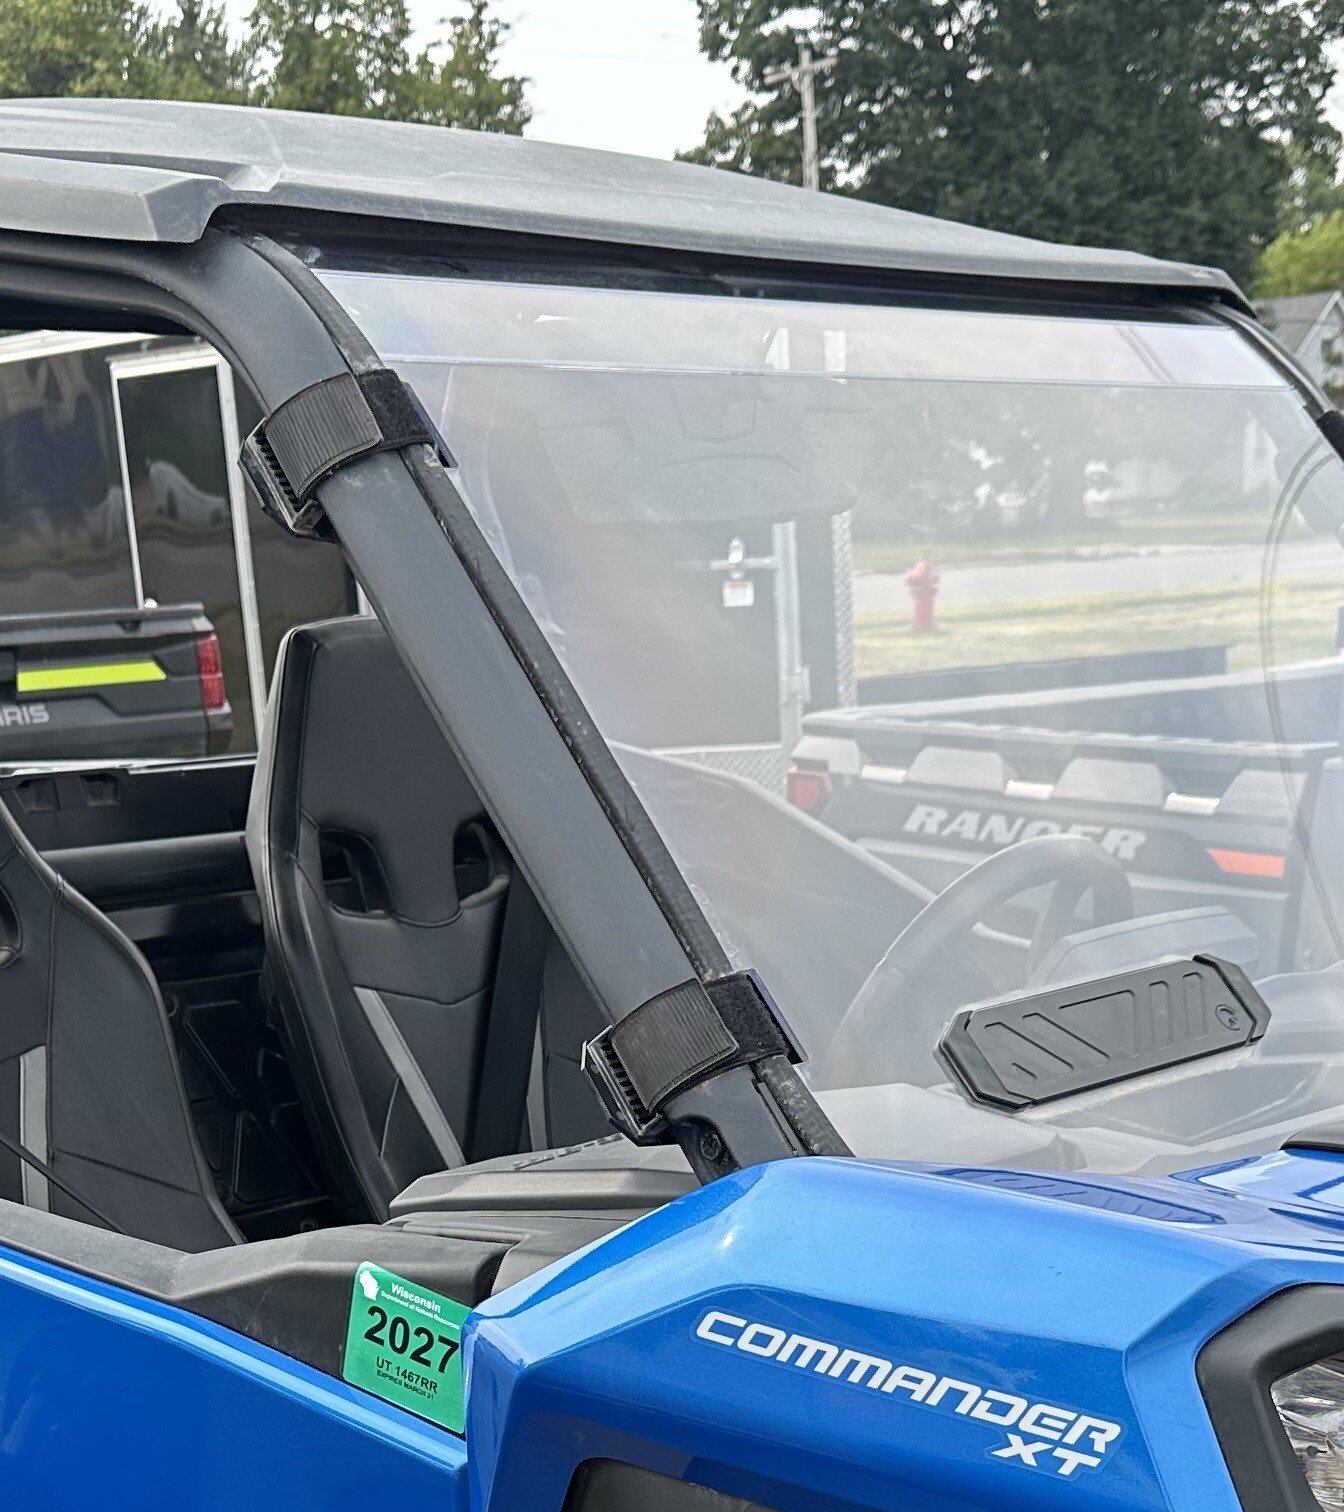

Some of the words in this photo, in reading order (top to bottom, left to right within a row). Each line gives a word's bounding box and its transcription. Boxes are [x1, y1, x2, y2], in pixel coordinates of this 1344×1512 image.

[391, 1282, 442, 1314] Wisconsin
[364, 1305, 460, 1374] 2027
[376, 1355, 393, 1371] UT
[396, 1365, 438, 1395] 1467RR
[695, 1310, 1122, 1454] COMMANDER
[990, 1432, 1103, 1476] XT
